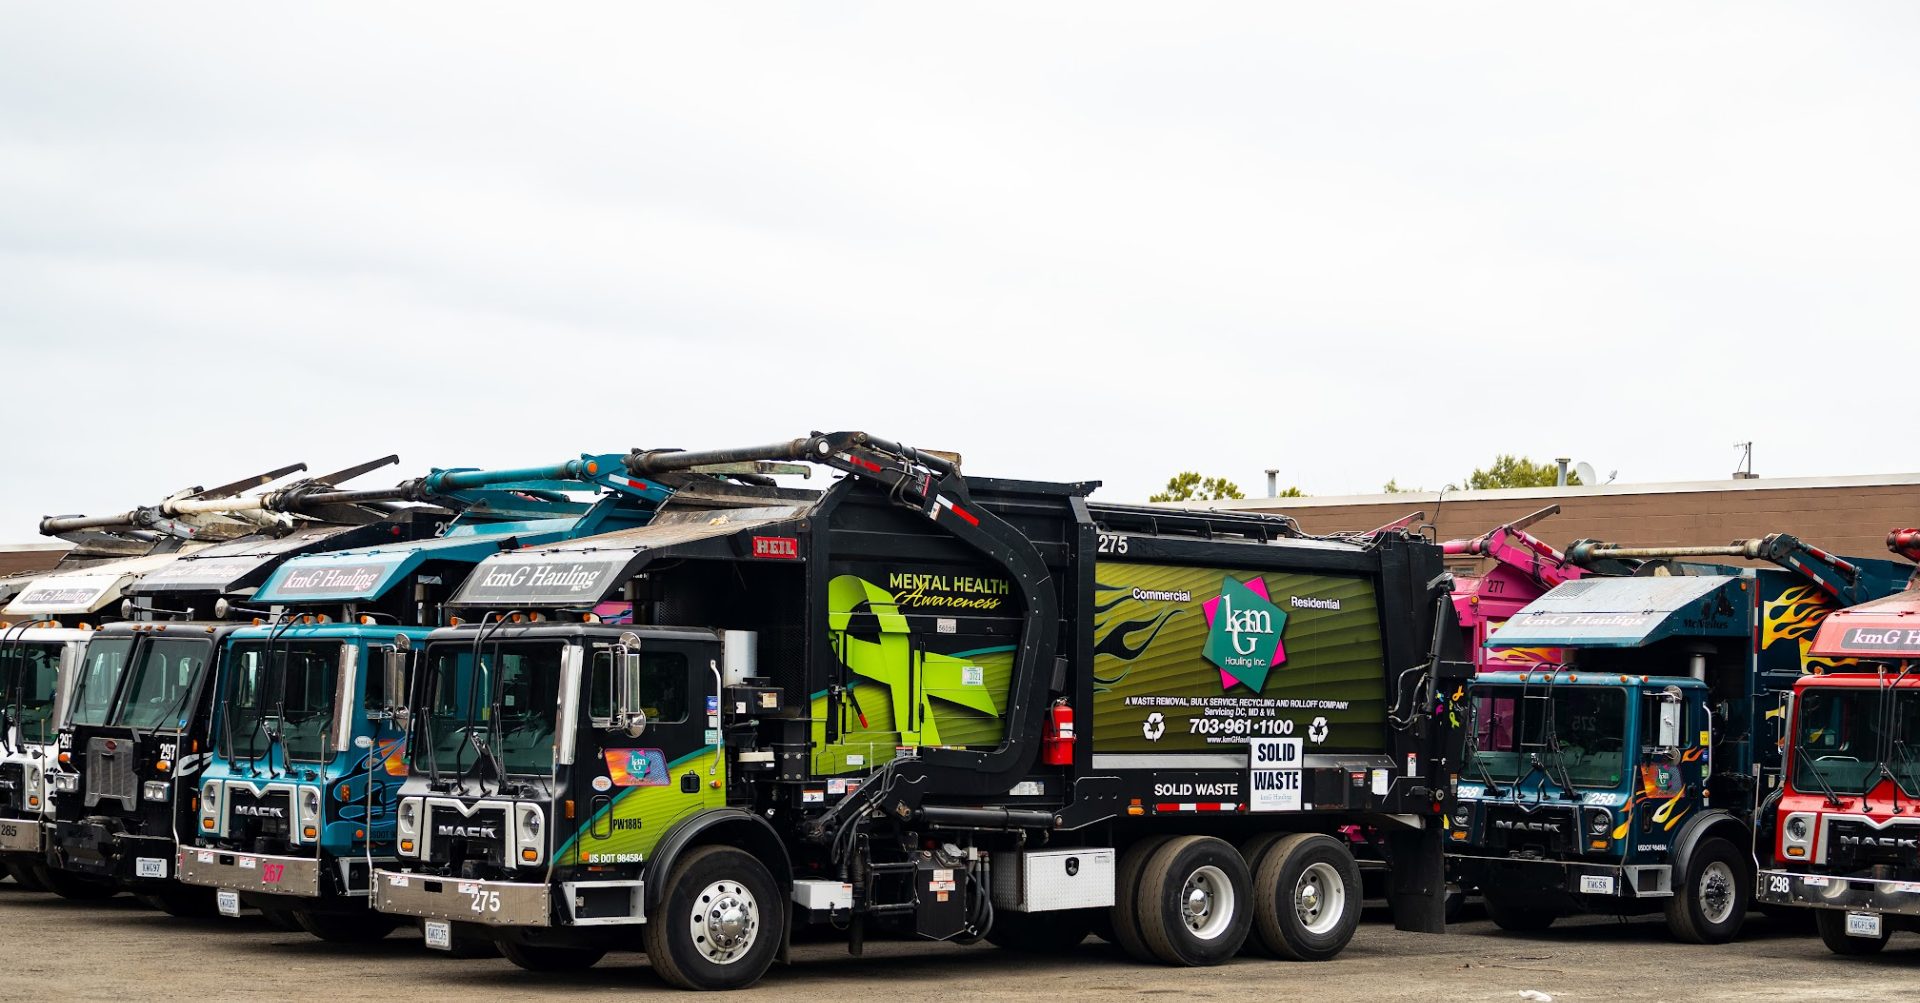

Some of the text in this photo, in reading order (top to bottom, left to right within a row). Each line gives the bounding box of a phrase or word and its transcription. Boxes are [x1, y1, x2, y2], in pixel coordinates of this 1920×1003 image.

[756, 540, 796, 555] HEIL
[1098, 534, 1128, 554] 275
[283, 567, 379, 589] kmG Hauling
[481, 564, 601, 589] kmG Hauling
[889, 572, 1009, 595] MENTAL HEALTH
[1487, 579, 1505, 594] 277
[893, 580, 1002, 609] Awareness
[1132, 587, 1191, 602] Commercial
[1290, 596, 1341, 610] Residential
[1851, 628, 1902, 645] kmG
[1225, 656, 1267, 668] Hauling Inc.
[1124, 696, 1349, 710] A WASTE REMOVAL, BULK SERVICE, RECYCLING AND ROLLOFF COMPANY
[1204, 707, 1276, 718] Servicing DC, MD & VA
[59, 732, 73, 749] 297
[160, 743, 177, 760] 297
[1257, 742, 1296, 762] SOLID
[1253, 771, 1299, 791] WASTE
[1154, 783, 1239, 796] SOLID WASTE
[1457, 786, 1480, 798] 258
[1588, 792, 1617, 805] 258
[235, 805, 284, 818] MACK
[1, 824, 17, 837] 285
[613, 818, 642, 830] PW1885
[1495, 820, 1560, 833] MACK
[438, 825, 497, 839] MACK
[1840, 835, 1918, 849] MACK
[589, 853, 643, 863] US DOT 984584
[262, 863, 285, 883] 267
[1769, 875, 1790, 893] 298
[471, 890, 501, 912] 275
